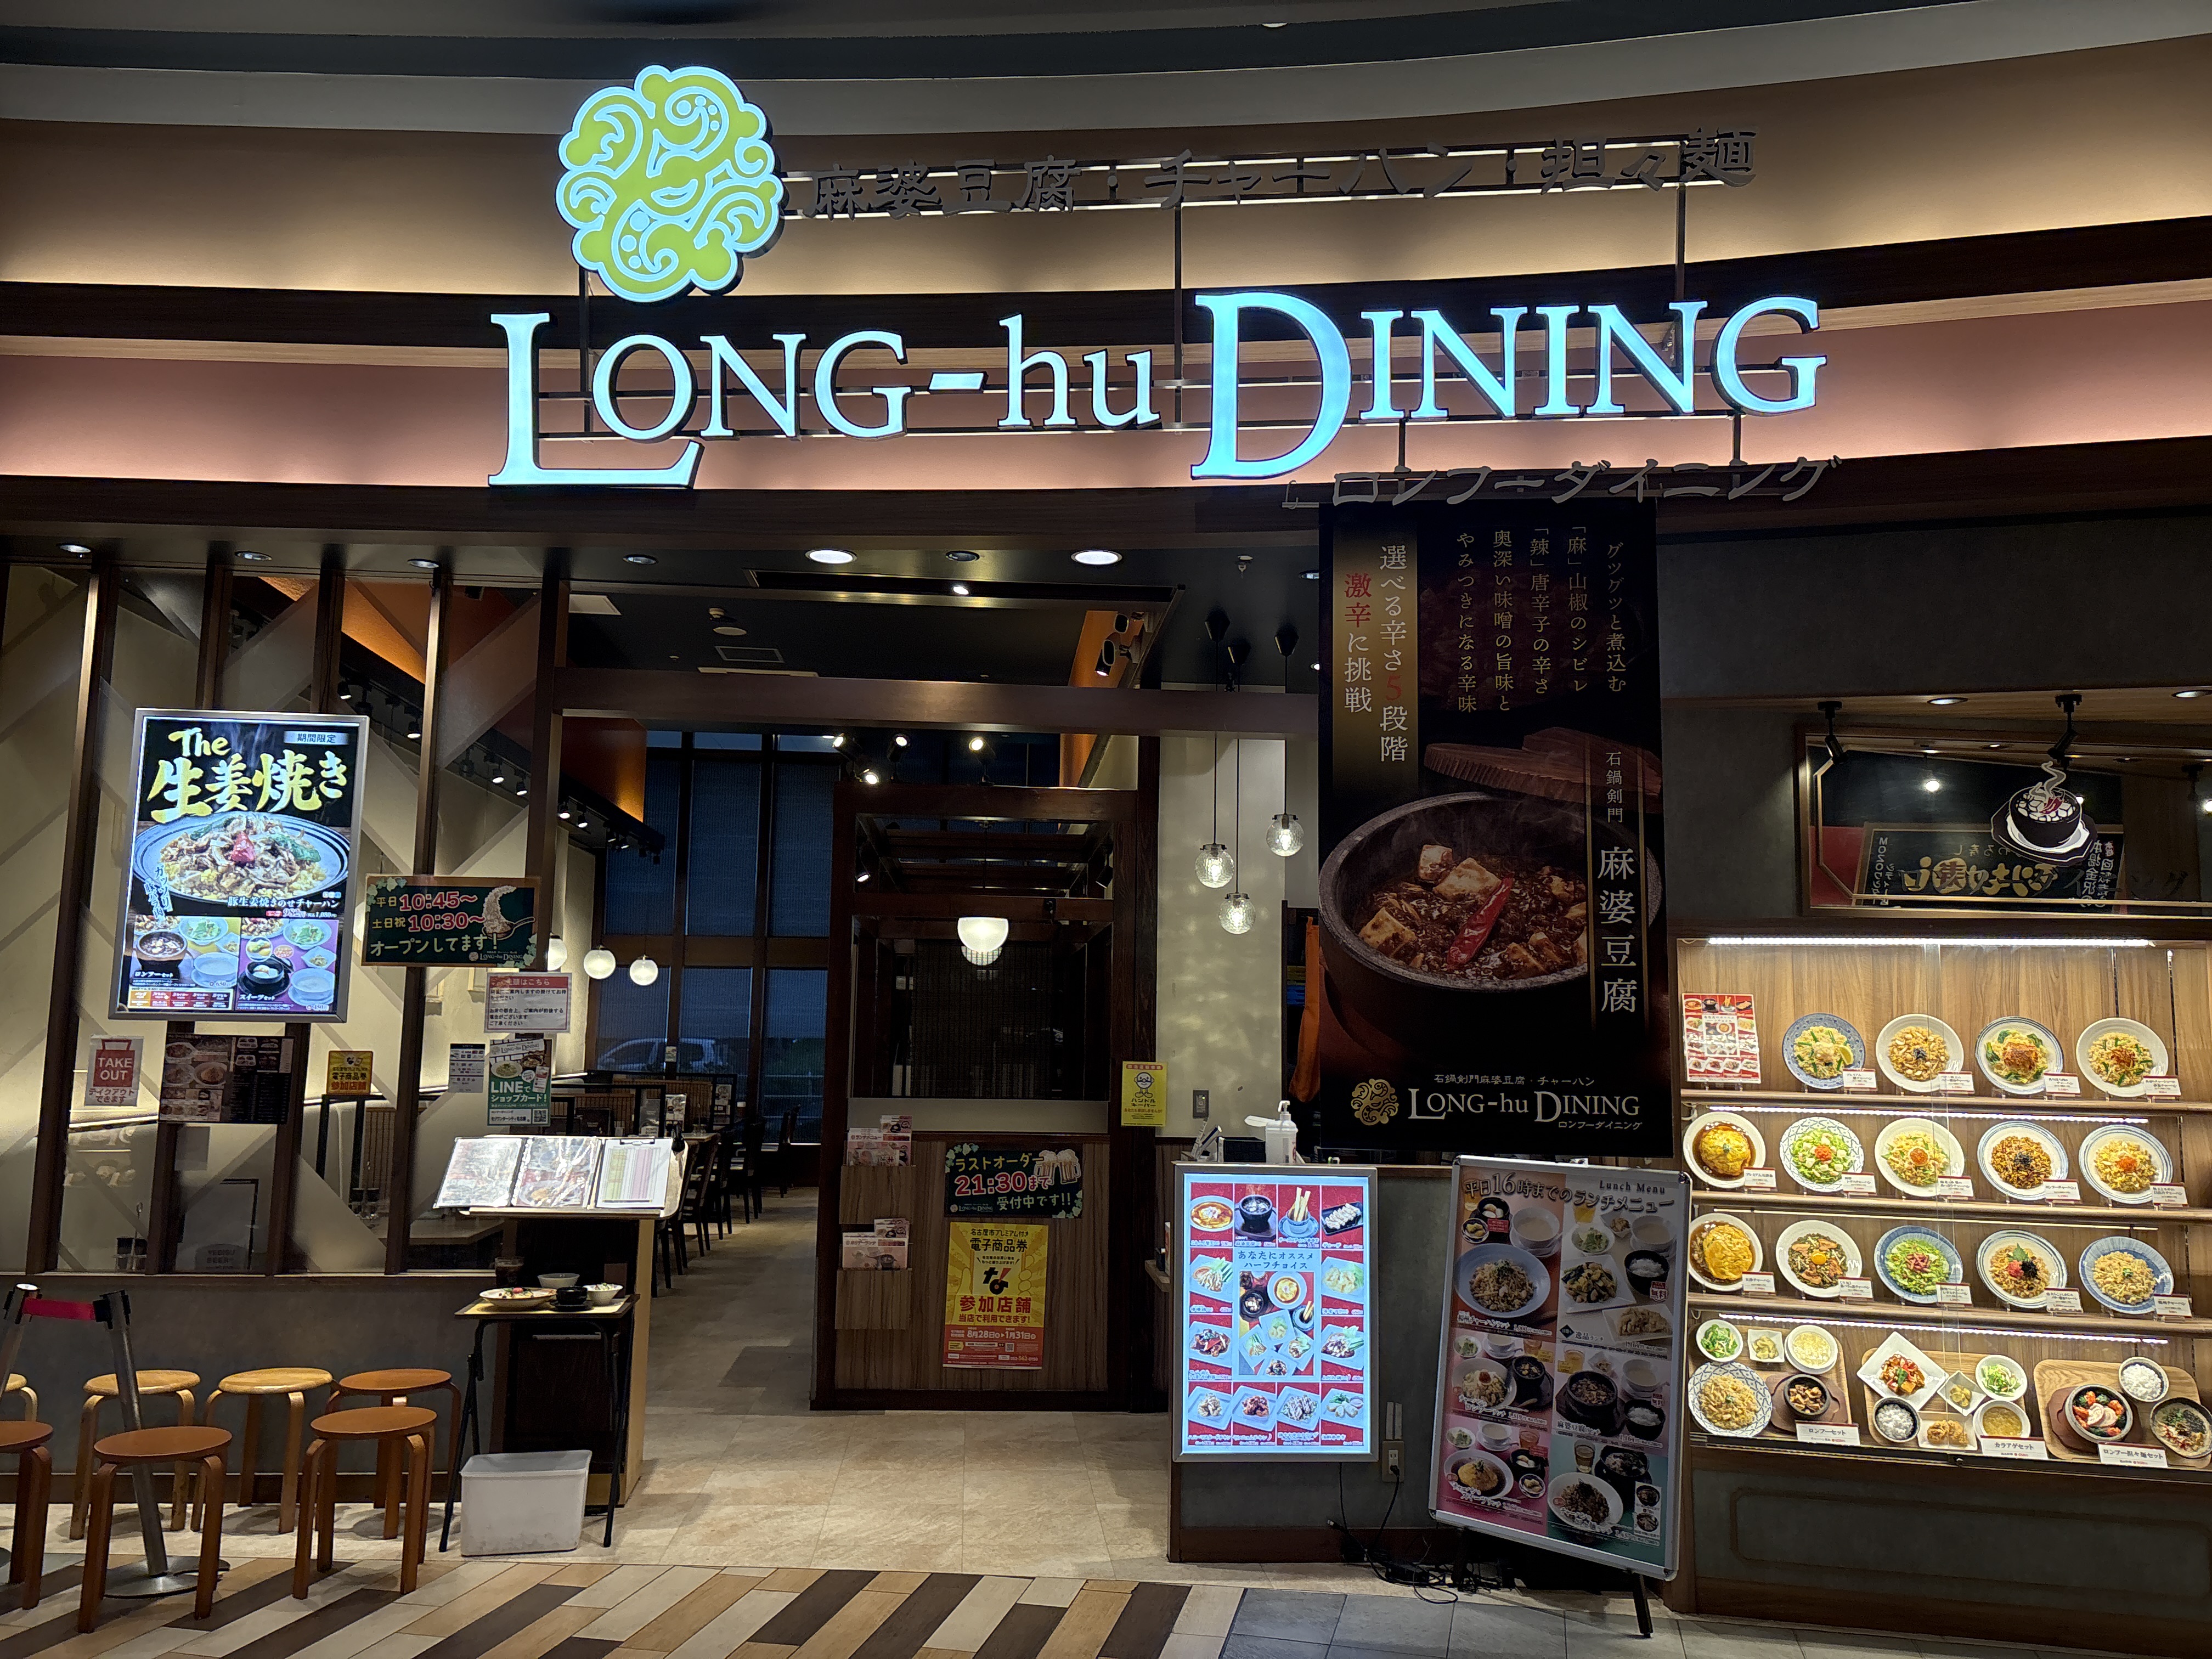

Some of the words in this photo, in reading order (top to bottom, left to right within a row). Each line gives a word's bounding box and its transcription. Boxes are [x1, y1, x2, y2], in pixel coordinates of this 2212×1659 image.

[488, 308, 1161, 488] LONG-hu
[1191, 292, 1828, 480] DINING
[1331, 454, 1842, 505] ロンフーダイニング
[1530, 527, 1551, 695] 「辣」唐辛子の辛さ
[1567, 526, 1588, 692] 「麻」山椒のシビレ
[1606, 543, 1626, 693] グツグツと煮込む
[1457, 533, 1477, 713] やみつきになる辛味
[1493, 529, 1514, 712] 奥深い味噌の旨味と
[1344, 573, 1372, 713] 激辛に挑戦
[1379, 545, 1408, 762] 選べる辛さ5段階
[167, 727, 232, 757] The
[296, 732, 336, 743] 期間限定
[146, 749, 348, 824] 生姜焼き
[1605, 751, 1623, 823] 石鍋剣門
[228, 895, 340, 909] 豚生姜焼きのせチャーハン
[1597, 845, 1638, 1013] 麻婆豆腐
[503, 953, 523, 961] DINING
[98, 1057, 132, 1069] TAKE
[100, 1070, 127, 1081] OUT
[490, 1081, 531, 1093] LINEで
[95, 1096, 126, 1104] できます
[1408, 1088, 1529, 1120] LONG-hu
[1534, 1091, 1640, 1122] DINING
[1558, 1121, 1642, 1131] ロンフーダイニング
[955, 1152, 1044, 1172] ラストオーダー
[954, 1171, 1052, 1197] 21:30まで
[1465, 1172, 1675, 1213] 平日16時までのランチメニュー
[1599, 1180, 1632, 1192] Lunch
[1637, 1183, 1666, 1195] Menu
[970, 1228, 1029, 1238] 名古屋市プレミアム付き
[969, 1237, 1028, 1252] 電子商品券
[1238, 1250, 1313, 1260] あなたにオススメ
[960, 1295, 1032, 1313] 参加店舗
[1808, 1427, 1846, 1436] ロンフーセット
[1994, 1442, 2034, 1451] カラアゲセット
[2103, 1449, 2164, 1460] ロンフー担々麺セット
